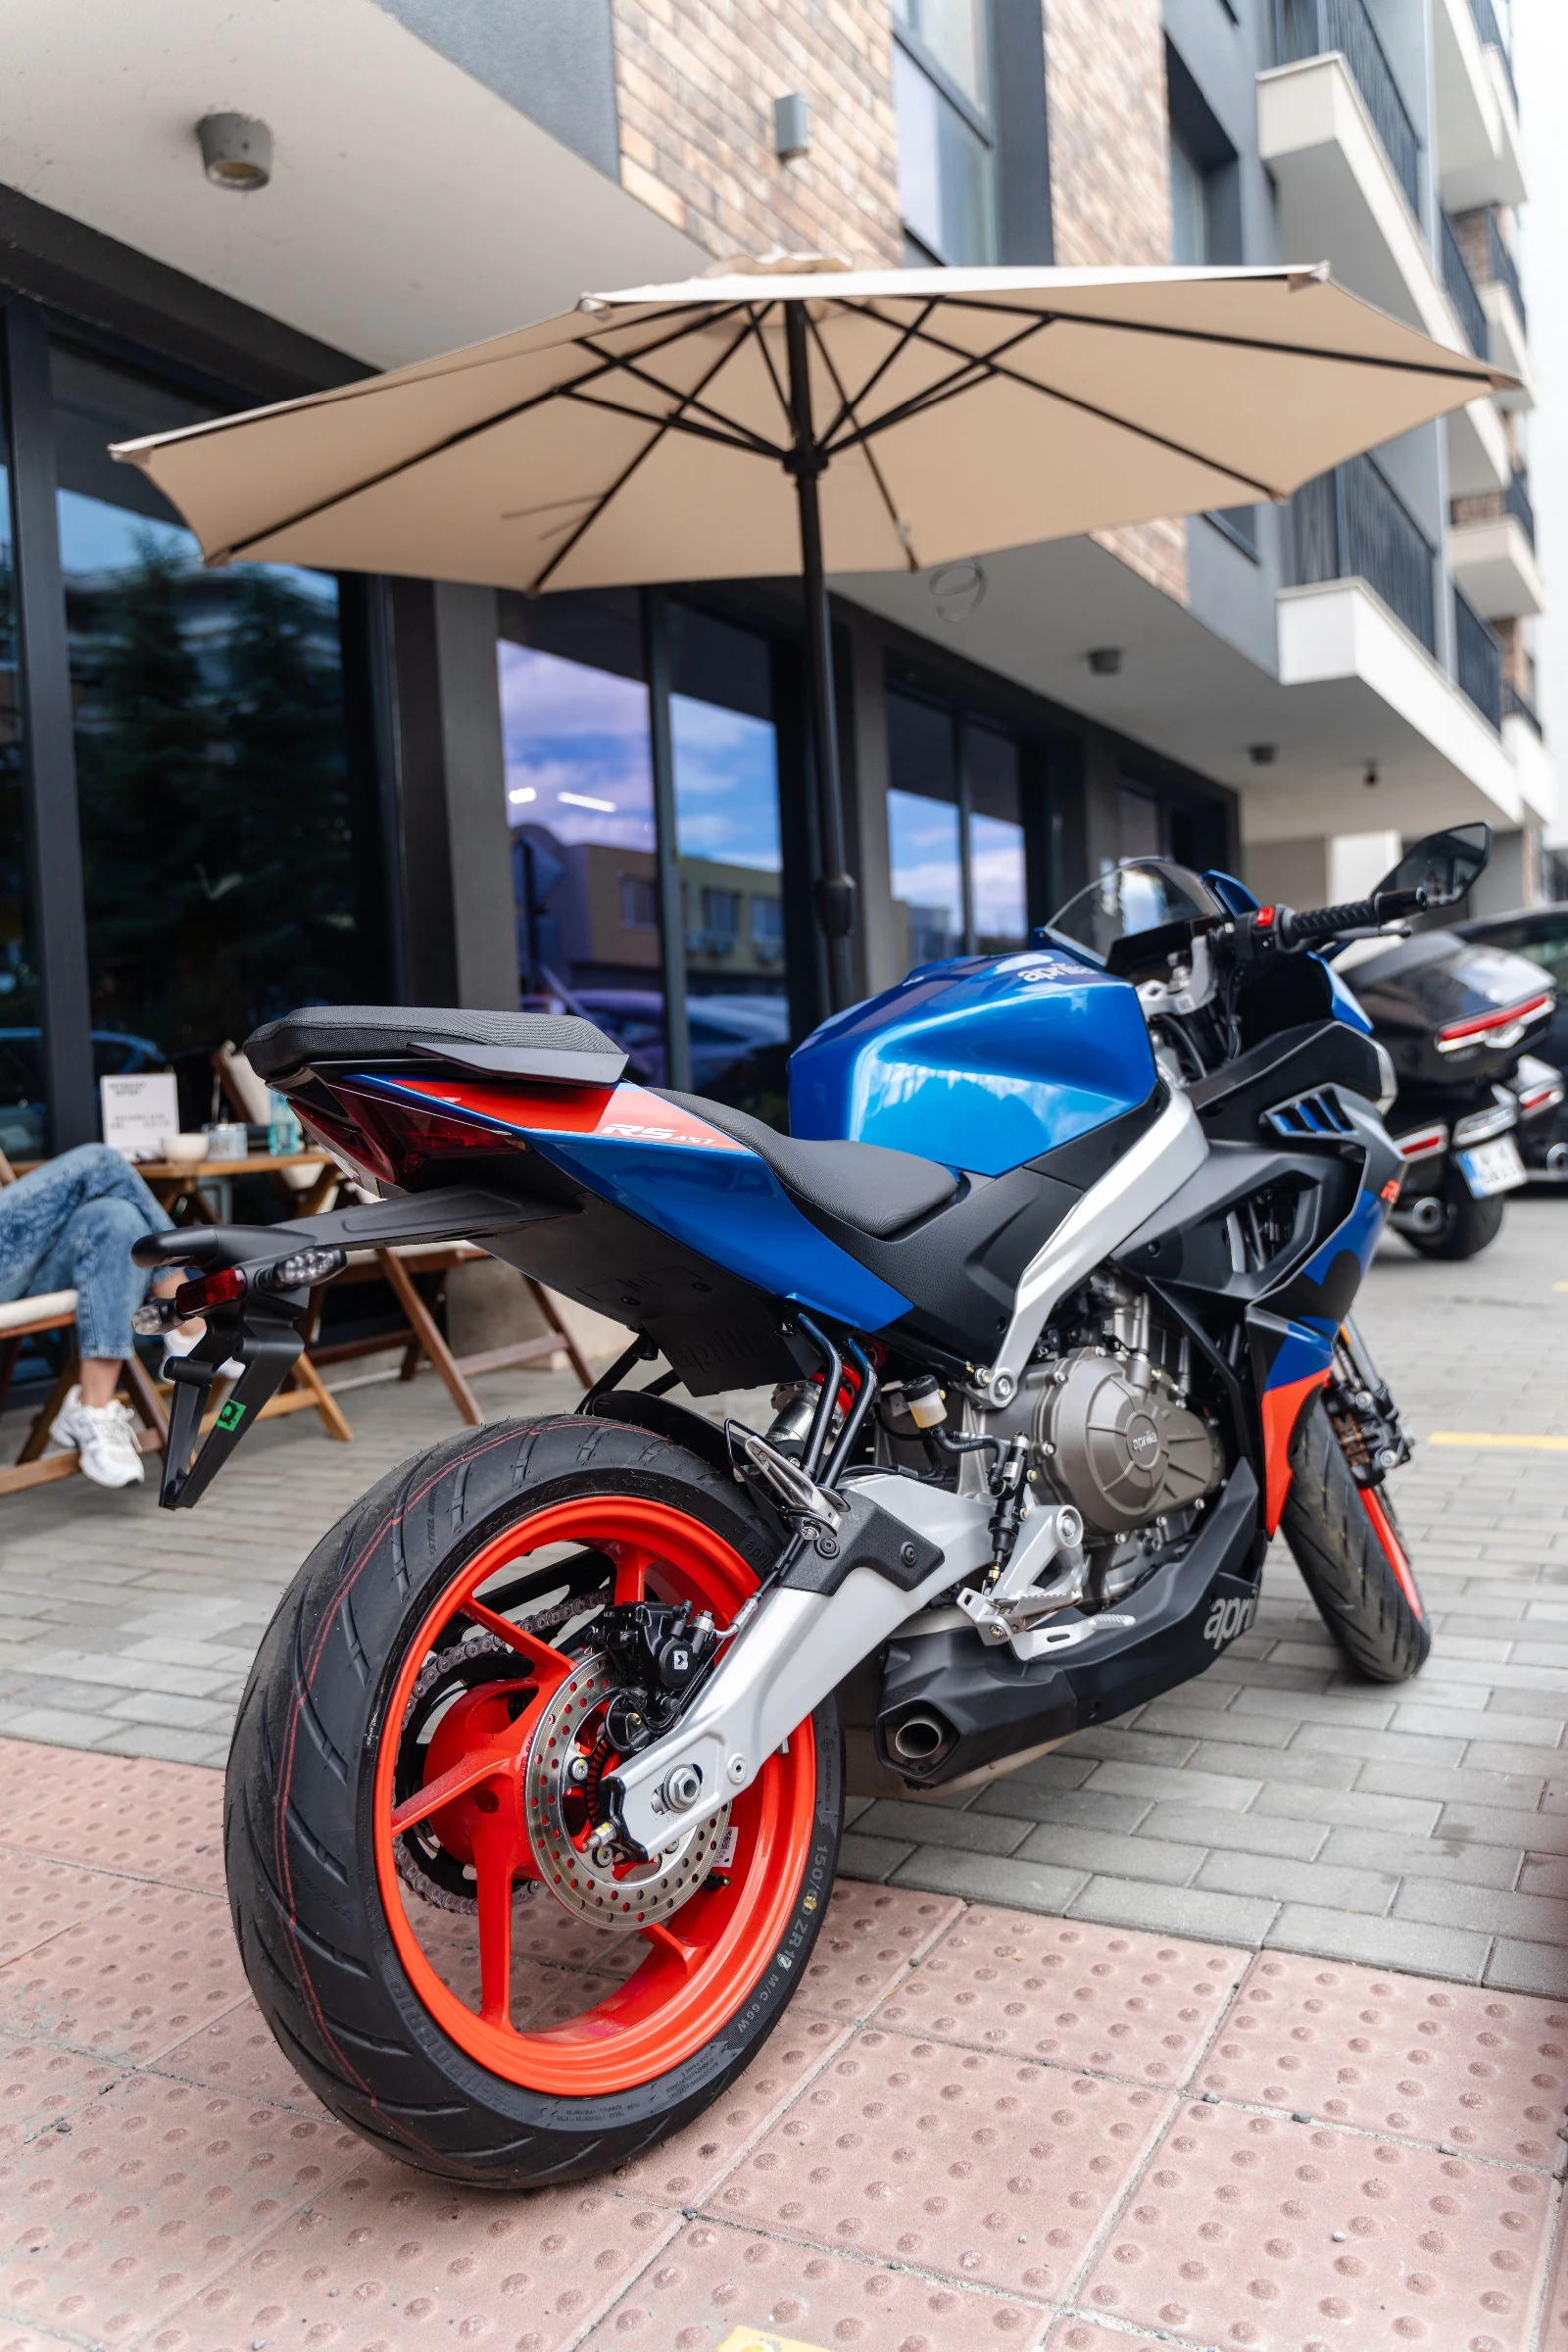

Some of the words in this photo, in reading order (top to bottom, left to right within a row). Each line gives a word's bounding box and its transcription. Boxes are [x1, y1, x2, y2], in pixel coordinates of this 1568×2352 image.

[1017, 962, 1101, 982] aprilia
[600, 1123, 678, 1140] RS
[672, 1135, 716, 1145] 457
[1132, 1430, 1158, 1452] aprilia
[760, 1974, 780, 2001] M/C
[736, 2003, 760, 2034] 66W
